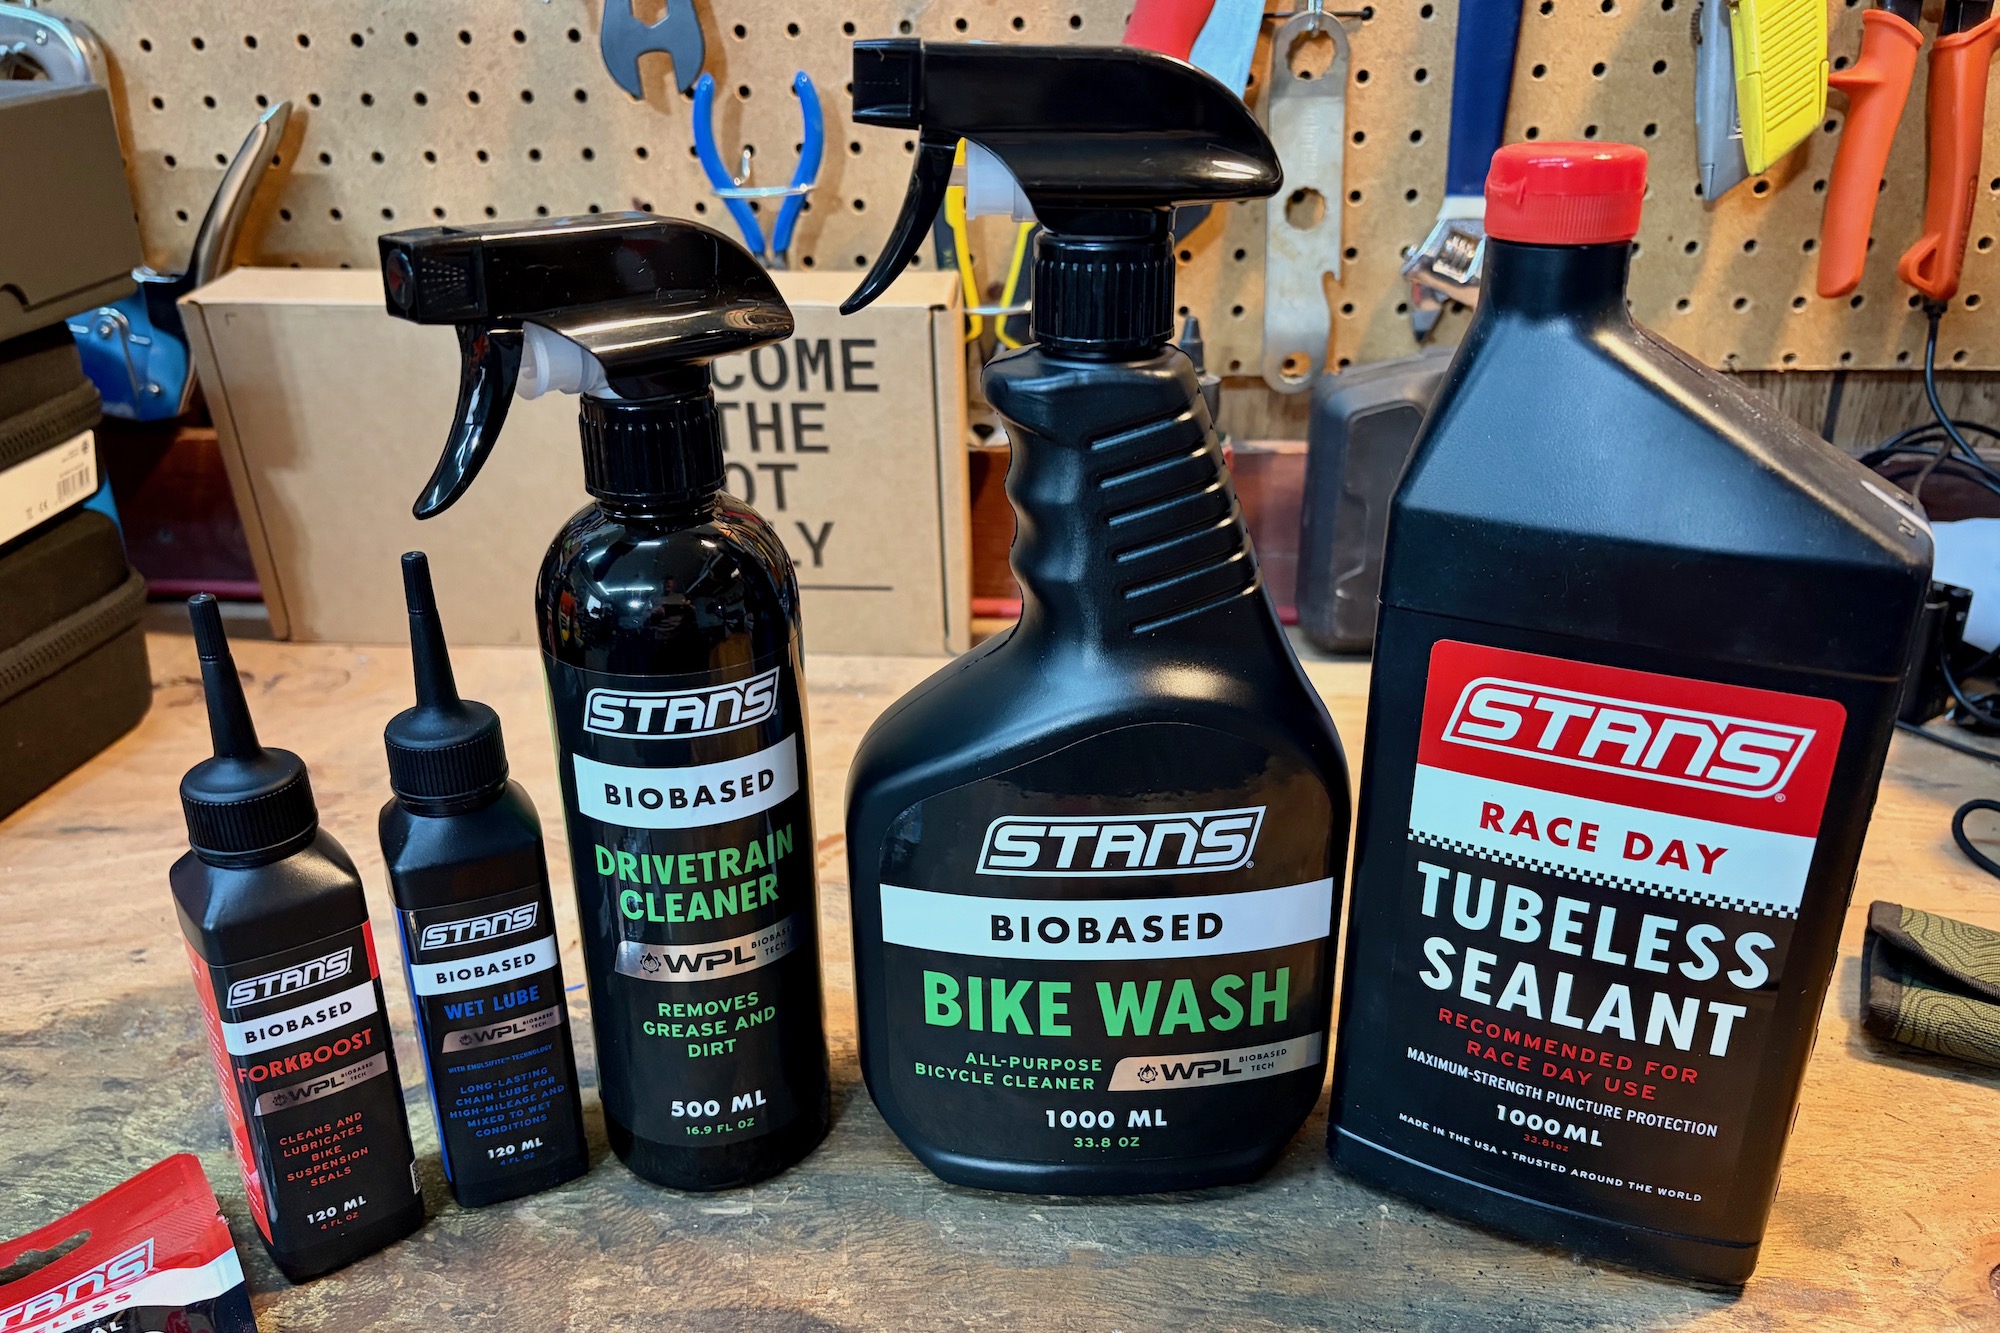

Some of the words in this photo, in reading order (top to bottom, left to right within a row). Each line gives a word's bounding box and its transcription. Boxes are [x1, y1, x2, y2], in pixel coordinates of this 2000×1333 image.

[711, 338, 879, 393] COME
[604, 768, 774, 810] BIOBASED
[1479, 801, 1600, 852] RACE
[1622, 831, 1729, 876] DAY
[594, 823, 793, 885] DRIVETRAIN
[619, 873, 779, 923] CLEANER
[751, 923, 795, 949] BIOBASE
[990, 912, 1223, 944] BIOBASED
[1417, 860, 1776, 990] TUBELESS
[663, 945, 756, 974] WPL
[765, 941, 787, 956] TECH
[436, 953, 536, 984] BIOBASED
[445, 999, 485, 1020] WET
[494, 985, 540, 1013] LUBE
[658, 991, 759, 1018] REMOVES
[923, 970, 1073, 1037] BIKE
[1095, 966, 1290, 1037] WASH
[1418, 935, 1747, 1058] SEALANT
[244, 1001, 352, 1044] BIOBASED
[473, 1023, 526, 1044] WPL
[531, 1020, 547, 1030] TECH
[643, 1020, 727, 1038] GREASE
[734, 1006, 776, 1031] AND
[237, 1028, 372, 1084] FORKBOOST
[687, 1038, 737, 1058] DIRT
[1239, 1047, 1287, 1063] BIOBASED
[1438, 1007, 1633, 1072] RECOMMENDED
[1644, 1061, 1699, 1084] FOR
[448, 1066, 466, 1074] WITH
[965, 1051, 1102, 1072] ALL-PURPOSE
[1160, 1056, 1242, 1081] WPL
[1251, 1061, 1274, 1072] TECH
[1466, 1040, 1531, 1072] RACE
[1542, 1063, 1593, 1087] DAY
[1603, 1077, 1658, 1101] USE
[288, 1076, 345, 1099] WPL
[460, 1067, 548, 1095] LONG-LASTING
[915, 1062, 994, 1086] BICYCLE
[1002, 1073, 1095, 1091] CLEANER
[449, 1094, 537, 1119] HIGH-MILEAGE
[542, 1084, 565, 1098] AND
[455, 1093, 494, 1107] CHAIN
[499, 1084, 529, 1099] LUBE
[533, 1076, 555, 1089] FOR
[671, 1099, 721, 1117] 500
[731, 1089, 767, 1113] ML
[1407, 1046, 1542, 1101] MAXIMUM-STRENGTH
[1546, 1091, 1622, 1120] PUNCTURE
[1626, 1110, 1718, 1138] PROTECTION
[279, 1123, 332, 1146] CLEANS
[336, 1112, 363, 1128] AND
[467, 1114, 505, 1128] MIXED
[509, 1109, 524, 1119] TO
[528, 1101, 552, 1114] WET
[475, 1113, 548, 1138] CONDITIONS
[686, 1126, 712, 1136] 16.9
[717, 1124, 733, 1134] FL
[738, 1118, 755, 1128] OZ
[1045, 1109, 1115, 1129] 1000
[1127, 1109, 1168, 1127] ML
[283, 1124, 364, 1158] LUBRICATES
[311, 1145, 343, 1162] BIKE
[487, 1144, 516, 1159] 120
[521, 1137, 544, 1151] ML
[1073, 1136, 1111, 1148] 33.8
[1119, 1136, 1140, 1148] OZ
[286, 1147, 369, 1182] SUSPENSION
[1399, 1113, 1430, 1133] MADE
[1432, 1126, 1446, 1137] IN
[1448, 1130, 1472, 1146] THE
[1474, 1139, 1498, 1156] USA
[1512, 1151, 1567, 1174] TRUSTED
[1570, 1168, 1624, 1188] AROUND
[1628, 1181, 1653, 1195] THE
[1657, 1187, 1703, 1203] WORLD
[310, 1166, 352, 1187] SEALS
[307, 1206, 337, 1224] 120
[343, 1195, 367, 1212] ML
[331, 1218, 343, 1227] FL
[345, 1211, 359, 1221] OZ
[0, 1247, 146, 1330] TANS
